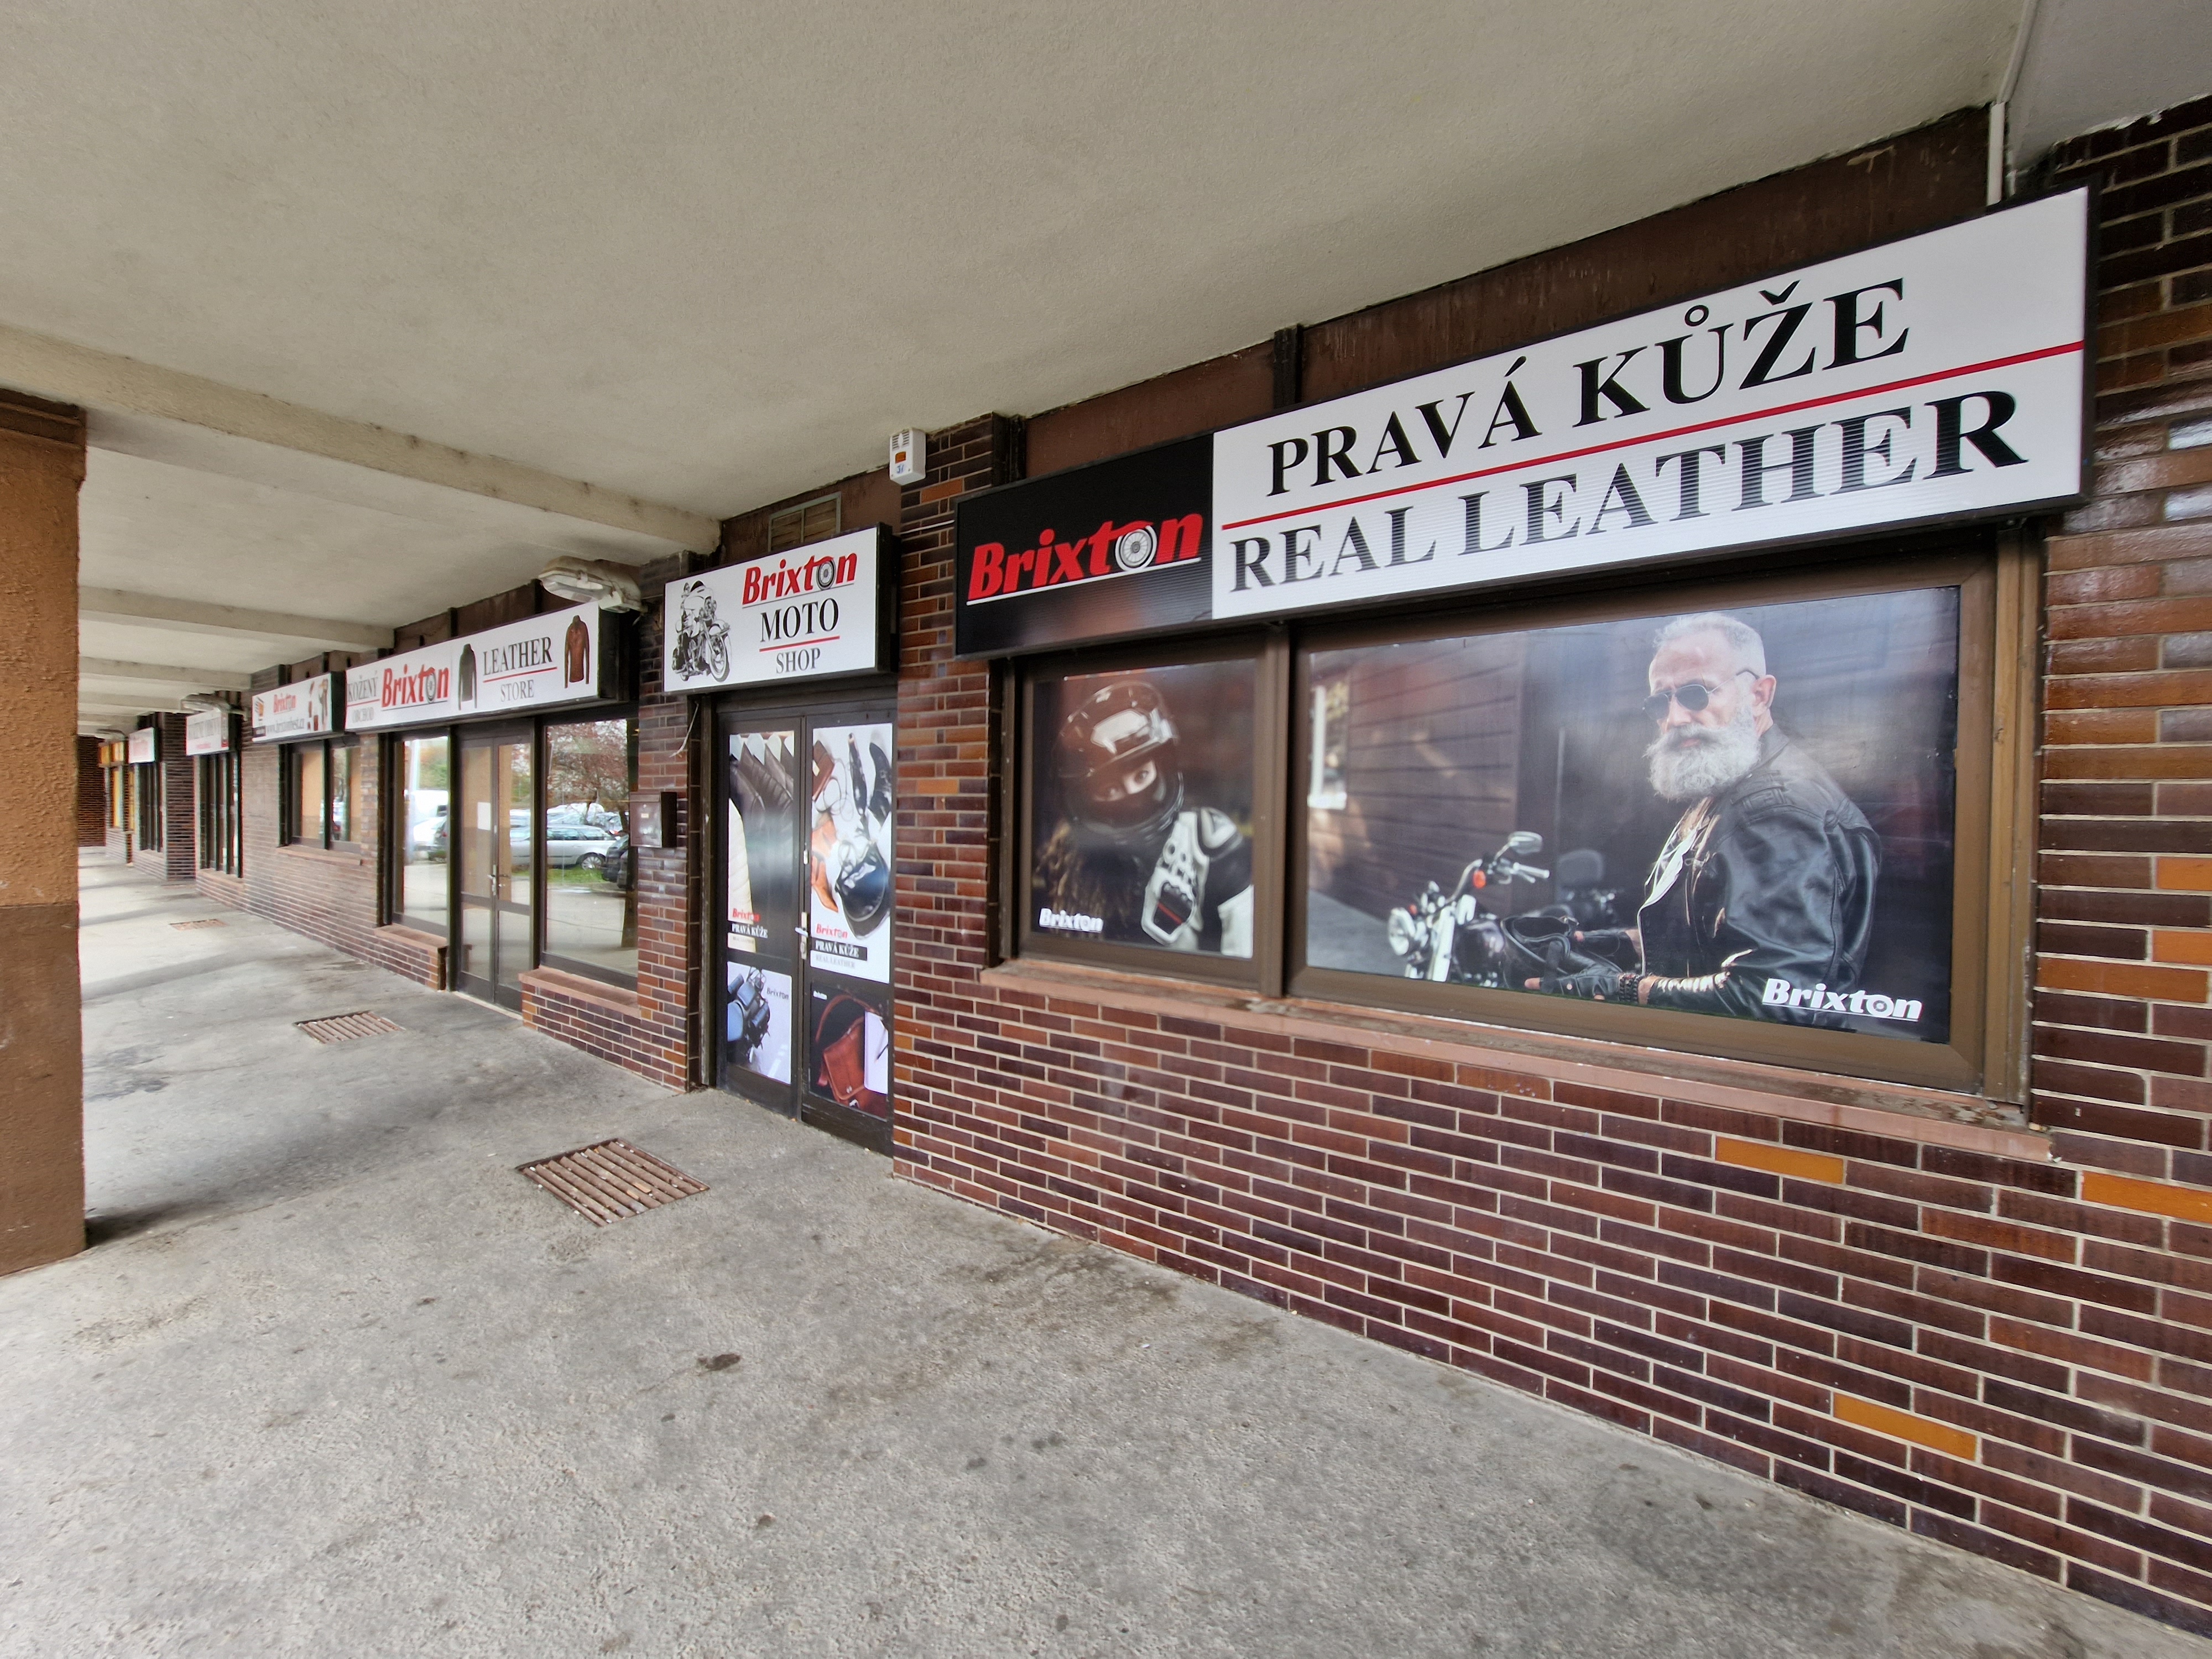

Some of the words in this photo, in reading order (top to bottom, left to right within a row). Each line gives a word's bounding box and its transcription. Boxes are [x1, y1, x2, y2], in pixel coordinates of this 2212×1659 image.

[1266, 356, 1542, 497] PRAVÁ
[1573, 278, 1909, 427] KŮŽE
[1230, 505, 1436, 592] REAL
[1458, 390, 2028, 555] LEATHER
[968, 513, 1203, 601] Brixton
[742, 552, 857, 605] Brixton
[760, 598, 839, 643] MOTO
[483, 637, 552, 676] LEATHER
[776, 648, 821, 674] SHOP
[382, 664, 449, 707] Brixton
[500, 680, 534, 702] STORE
[732, 923, 750, 935] PRAVÁ
[733, 908, 760, 922] Brixton
[816, 924, 848, 938] Brixton
[1040, 908, 1103, 932] Brixton
[815, 940, 838, 954] PRAVÁ
[766, 987, 789, 1000] Brixton
[1762, 978, 1922, 1020] Brixton
